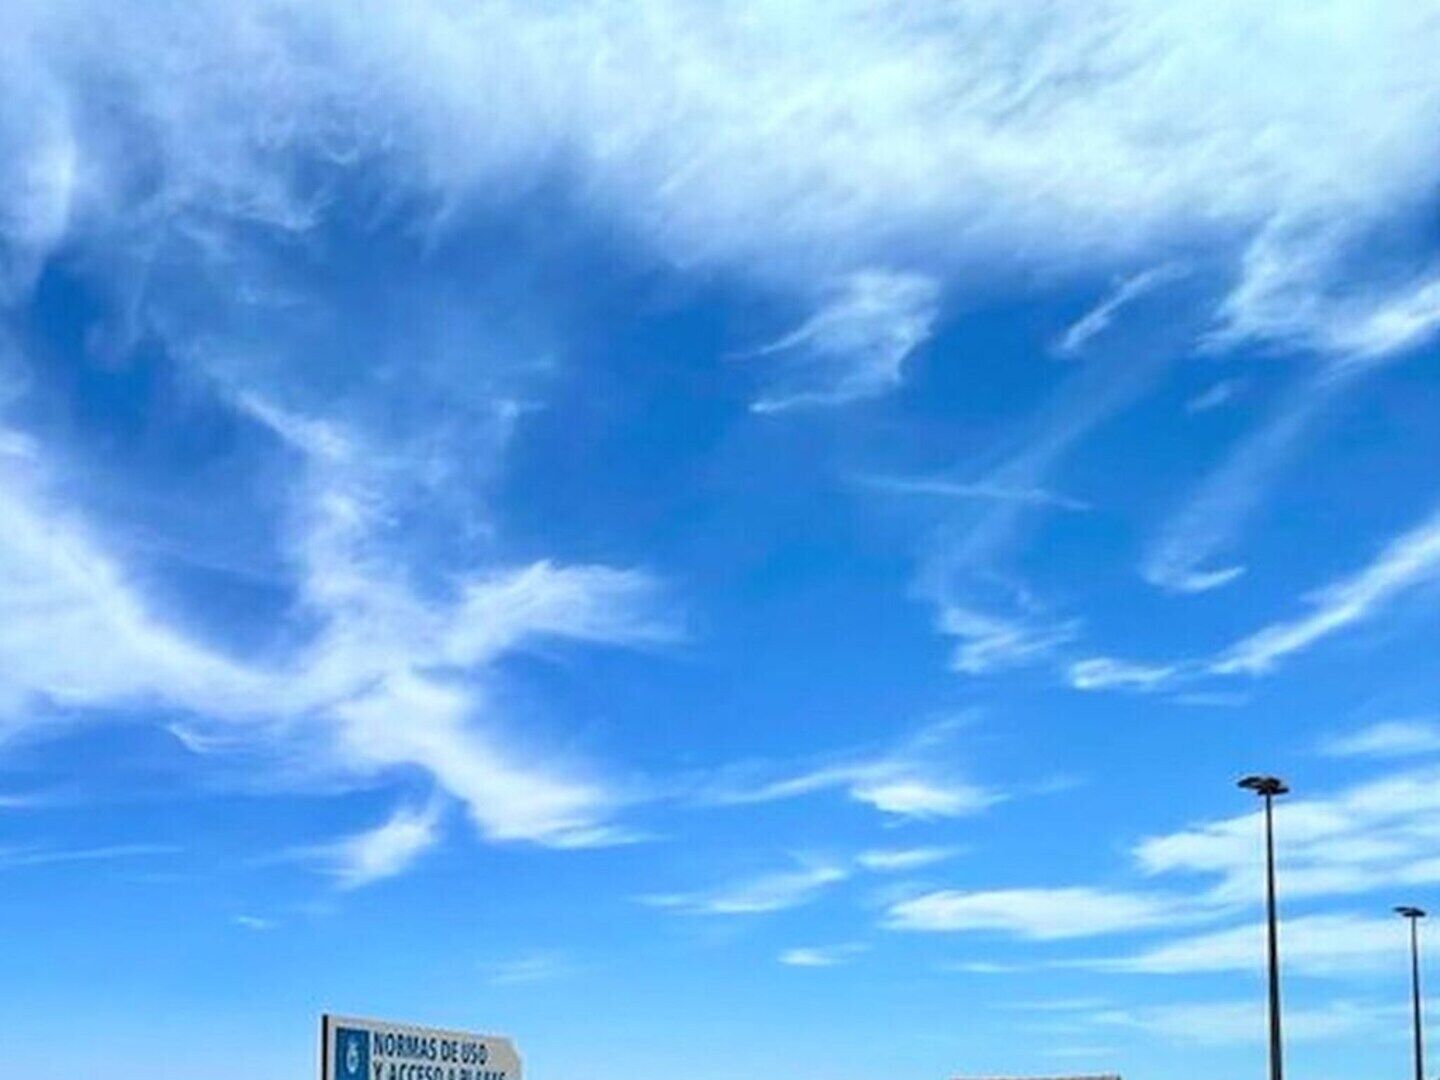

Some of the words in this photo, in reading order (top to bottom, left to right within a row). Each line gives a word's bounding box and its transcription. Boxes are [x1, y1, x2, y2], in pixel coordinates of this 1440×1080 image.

[373, 1032, 436, 1061] NORMAS
[441, 1040, 458, 1063] DE
[461, 1042, 488, 1065] USO
